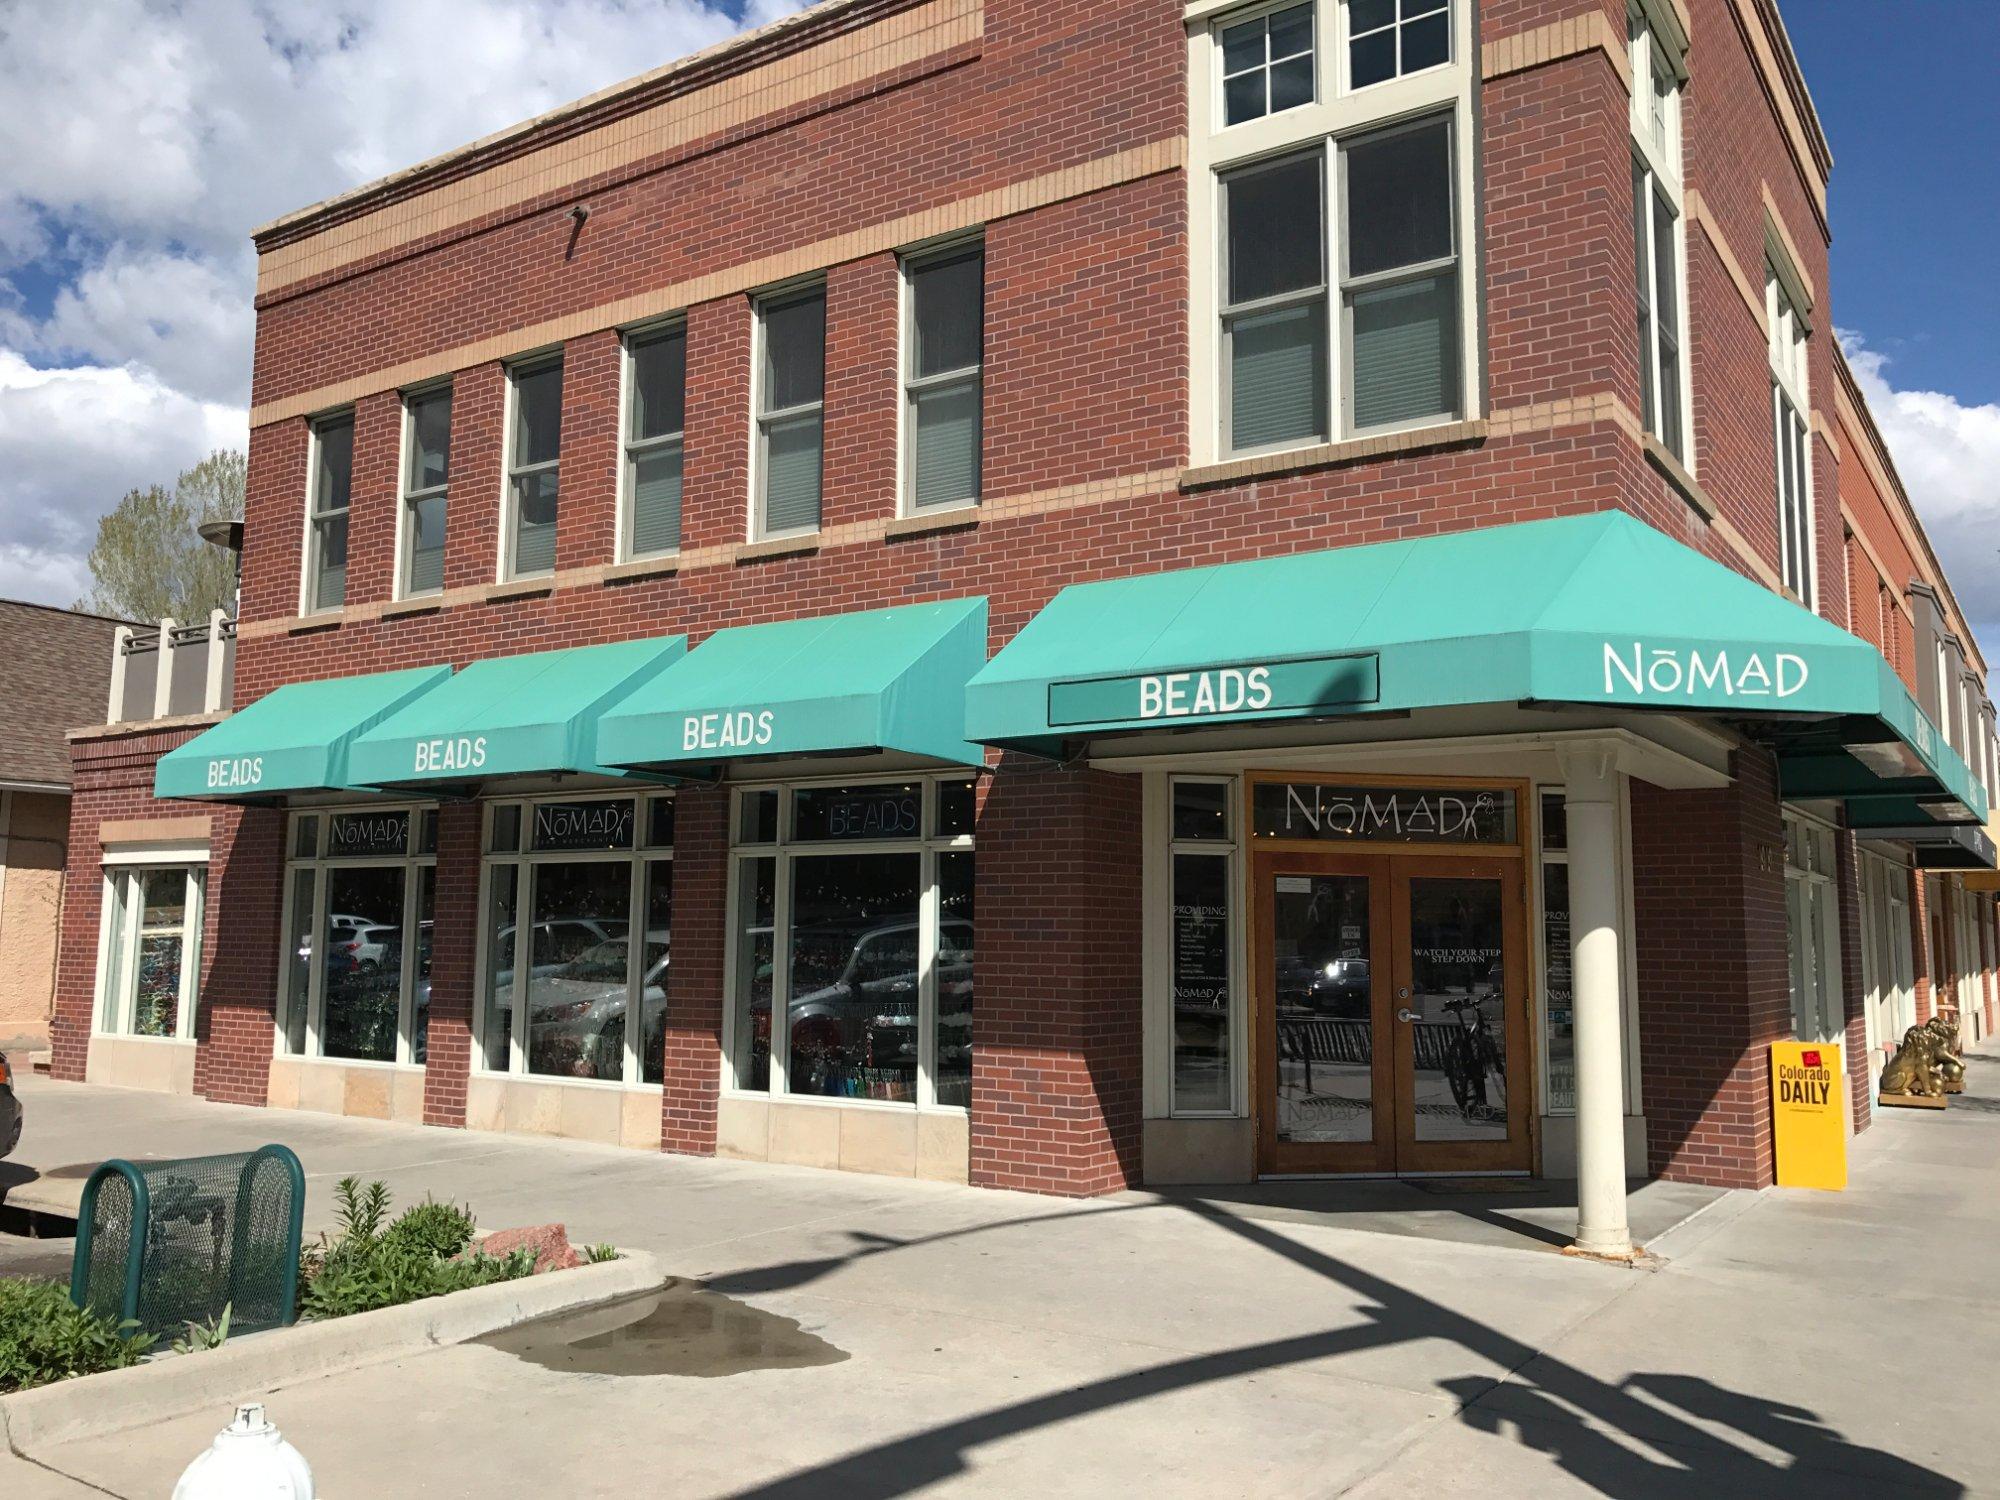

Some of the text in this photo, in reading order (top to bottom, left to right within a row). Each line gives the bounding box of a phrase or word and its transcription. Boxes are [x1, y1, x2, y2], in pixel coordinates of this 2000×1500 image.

[1140, 667, 1272, 718] BEADS
[682, 710, 775, 751] BEADS
[414, 736, 487, 772] BEADS
[207, 757, 263, 788] BEADS
[830, 799, 916, 835] BEADS
[1174, 905, 1227, 916] PROVIDING
[1413, 948, 1502, 957] WATCH YOUR STEP
[1431, 955, 1485, 963] STEP DOWN
[1779, 1064, 1831, 1082] Colorado
[1780, 1080, 1830, 1105] DAILY
